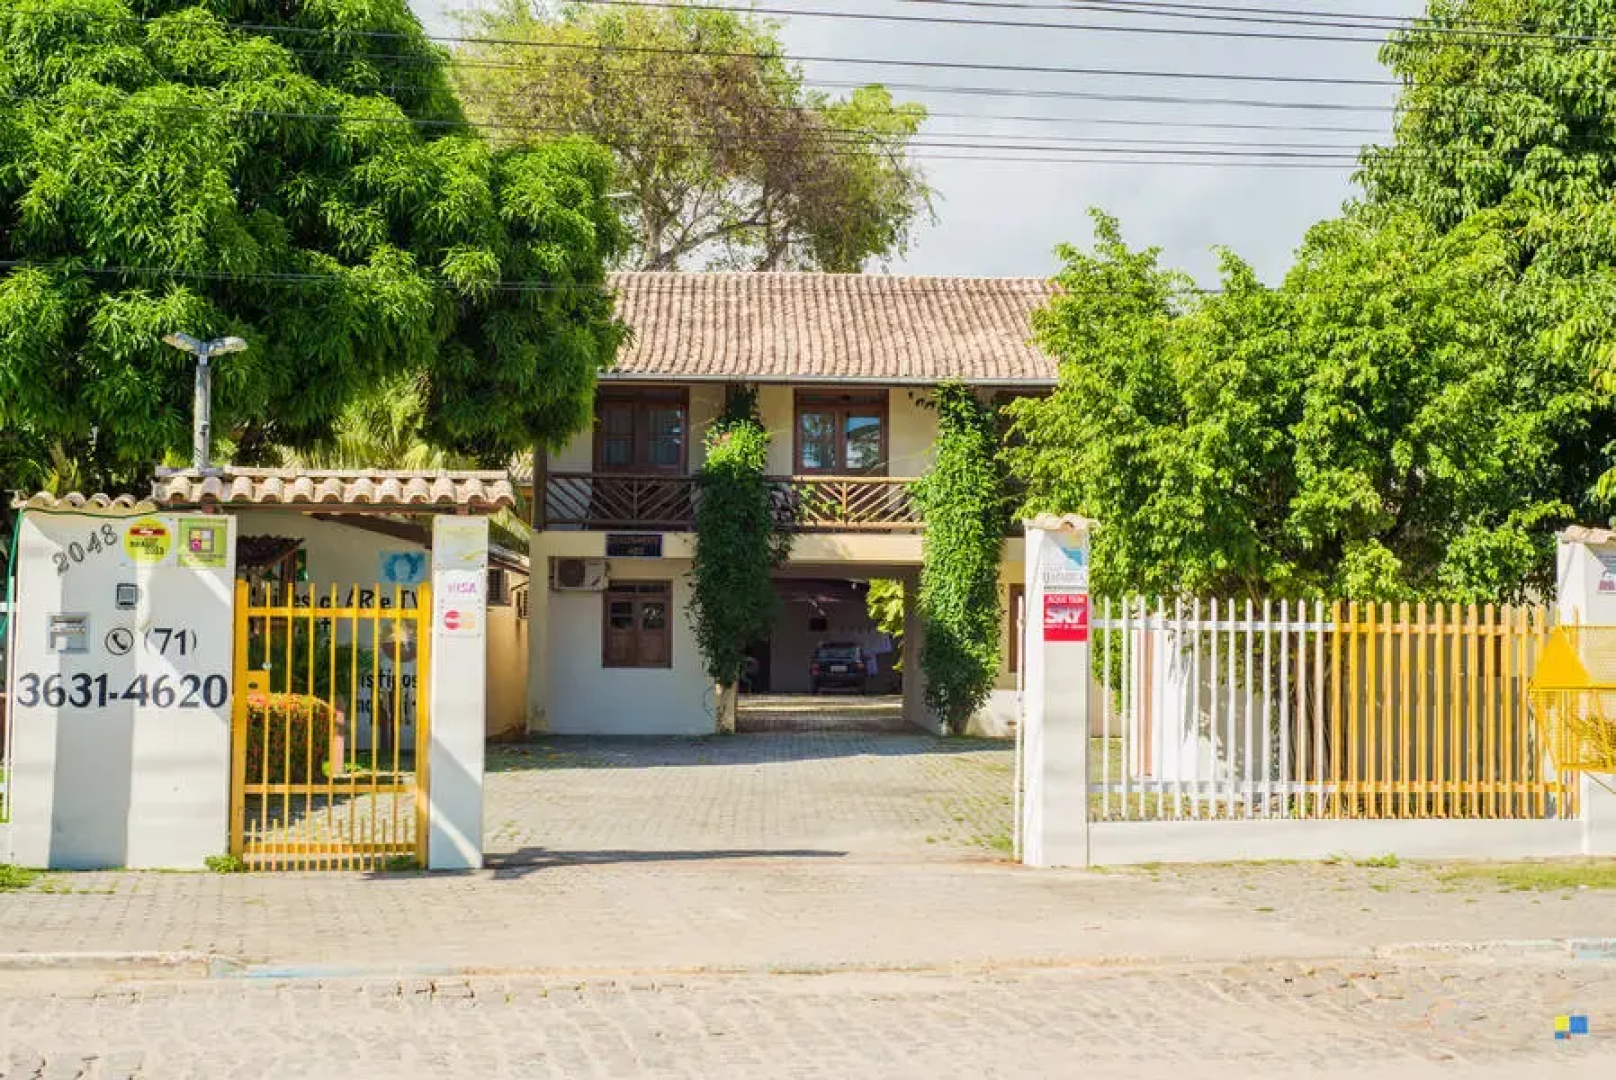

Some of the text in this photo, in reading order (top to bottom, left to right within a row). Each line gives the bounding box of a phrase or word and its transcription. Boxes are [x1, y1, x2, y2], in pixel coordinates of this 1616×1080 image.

[52, 523, 118, 576] 2048
[1045, 604, 1085, 623] SKY
[144, 624, 197, 656] (71)
[17, 673, 228, 708] 3631-4620
